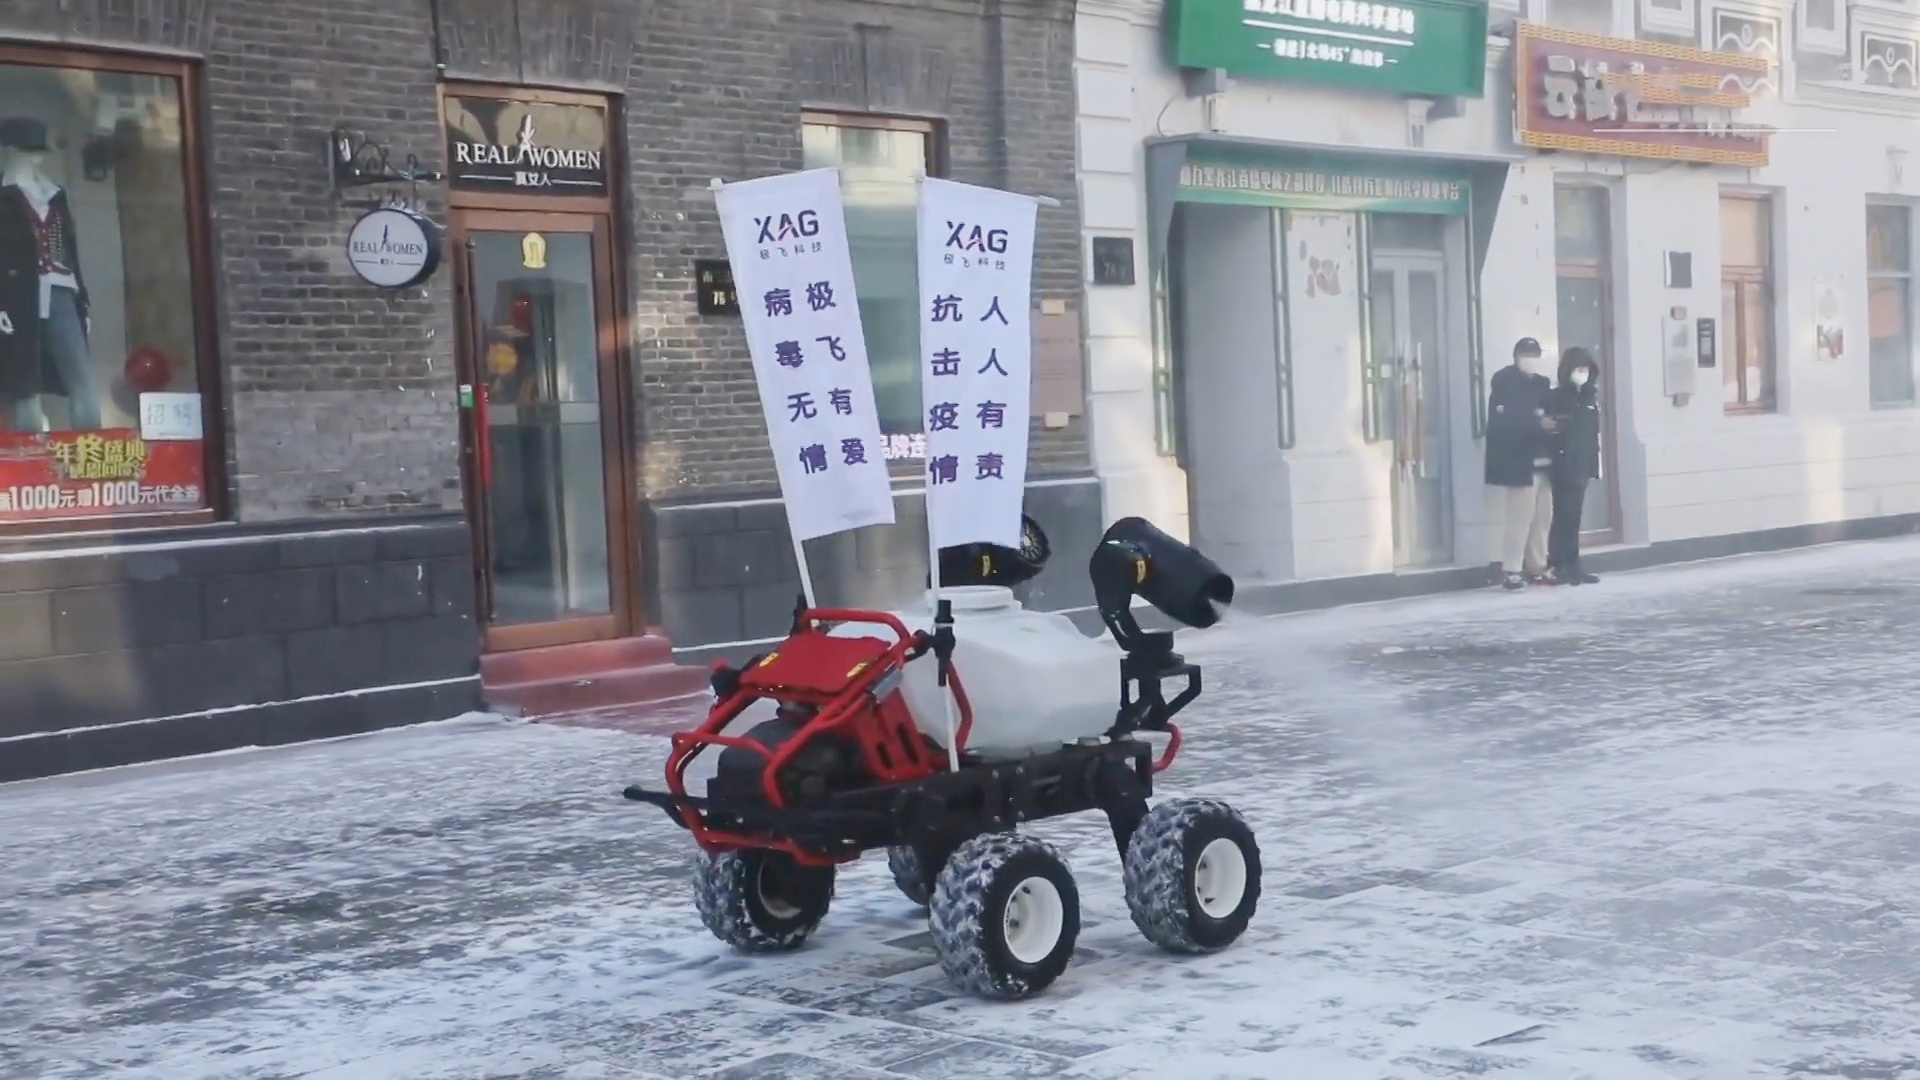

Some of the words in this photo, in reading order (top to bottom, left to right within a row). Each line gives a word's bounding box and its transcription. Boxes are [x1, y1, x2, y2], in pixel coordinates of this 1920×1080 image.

[456, 141, 516, 165] REAL
[528, 147, 601, 170] WOMEN
[753, 209, 819, 244] XAG
[945, 220, 1008, 254] XAG
[353, 241, 380, 254] REAL
[384, 243, 423, 256] WOMEN
[760, 242, 823, 260] 极飞科技
[943, 254, 1007, 271] 极飞科技
